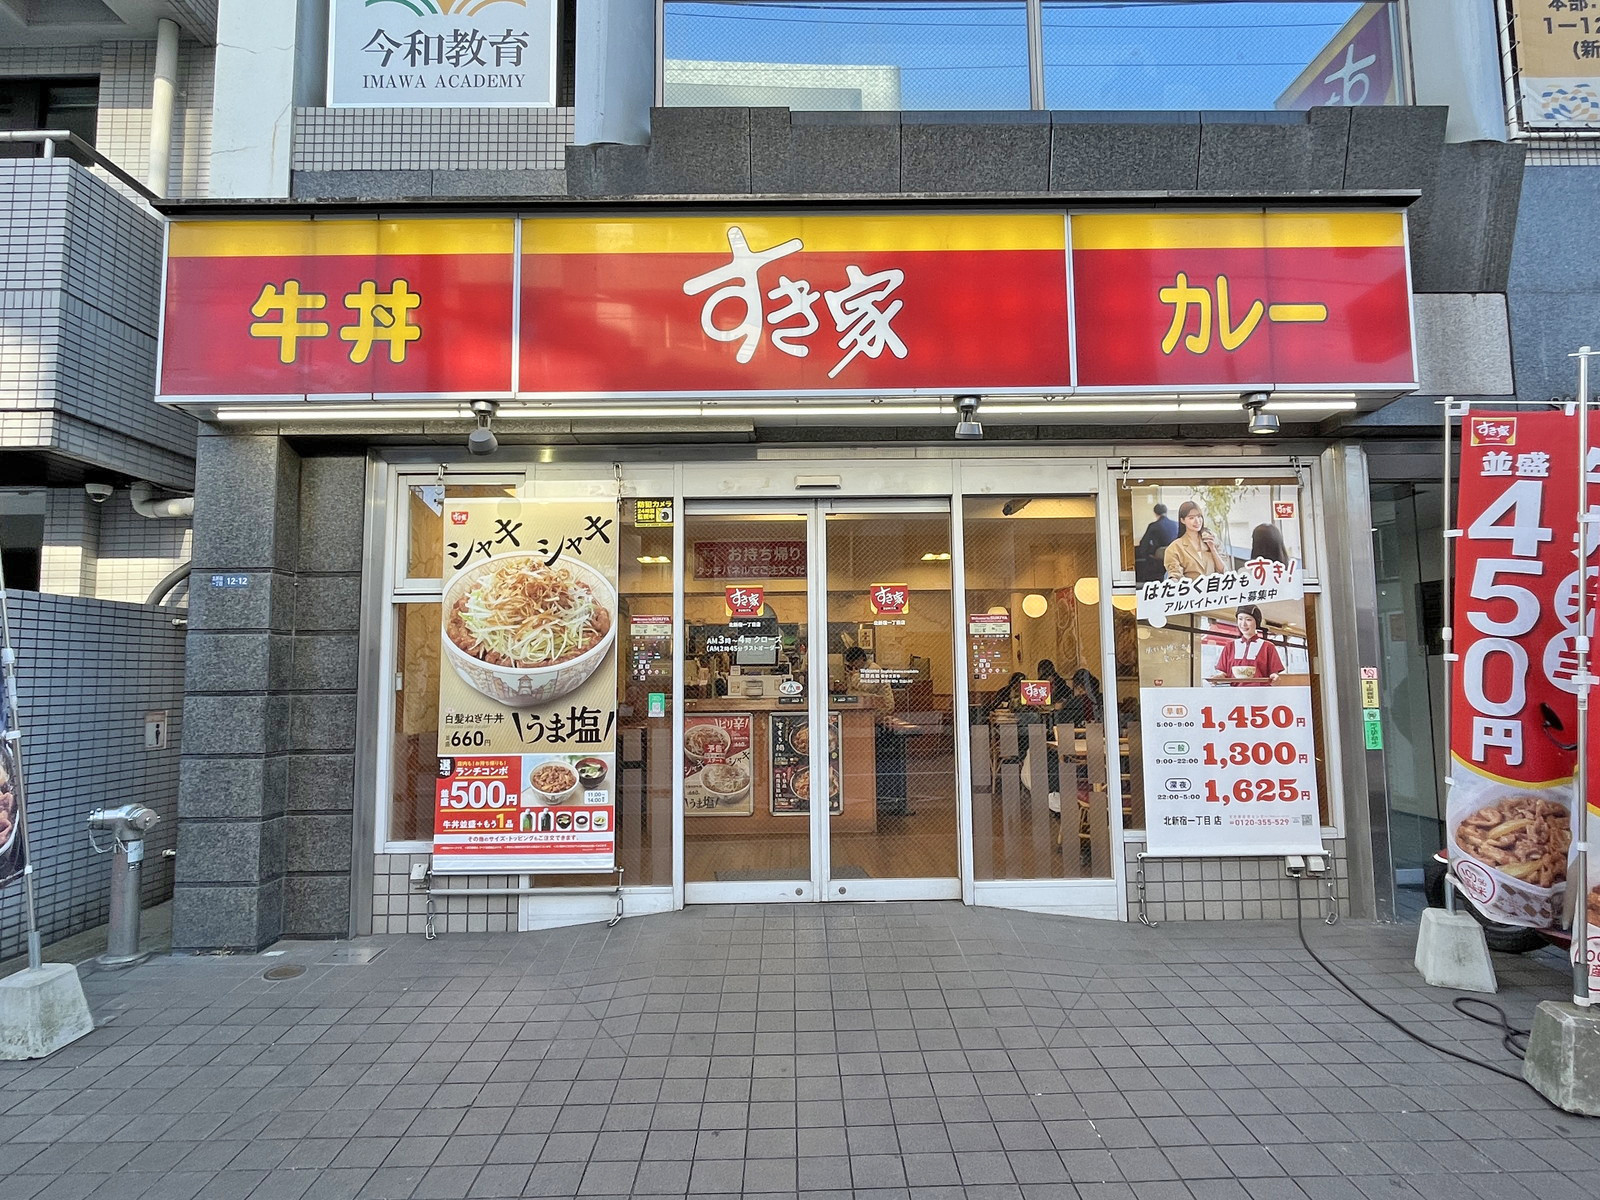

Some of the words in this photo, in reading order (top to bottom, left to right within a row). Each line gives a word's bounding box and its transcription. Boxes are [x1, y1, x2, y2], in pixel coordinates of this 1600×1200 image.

[362, 28, 529, 67] 今和教育
[363, 74, 427, 89] IMAWA
[435, 74, 526, 89] ACADEMY
[683, 226, 908, 379] すき家
[250, 279, 422, 364] 牛丼
[1158, 272, 1328, 355] カレー
[1480, 451, 1550, 477] 並盛
[447, 519, 523, 570] シャキ
[537, 516, 612, 567] シャキ
[728, 546, 801, 561] お持ち帰り
[730, 588, 760, 609] すき家
[874, 586, 905, 607] すき家
[1024, 682, 1048, 699] すき家
[445, 713, 504, 724] 白髪ねぎ牛丼
[526, 706, 602, 744] うま塩
[456, 766, 508, 776] ランチコンボ
[1235, 818, 1290, 826] 0120-355-529
